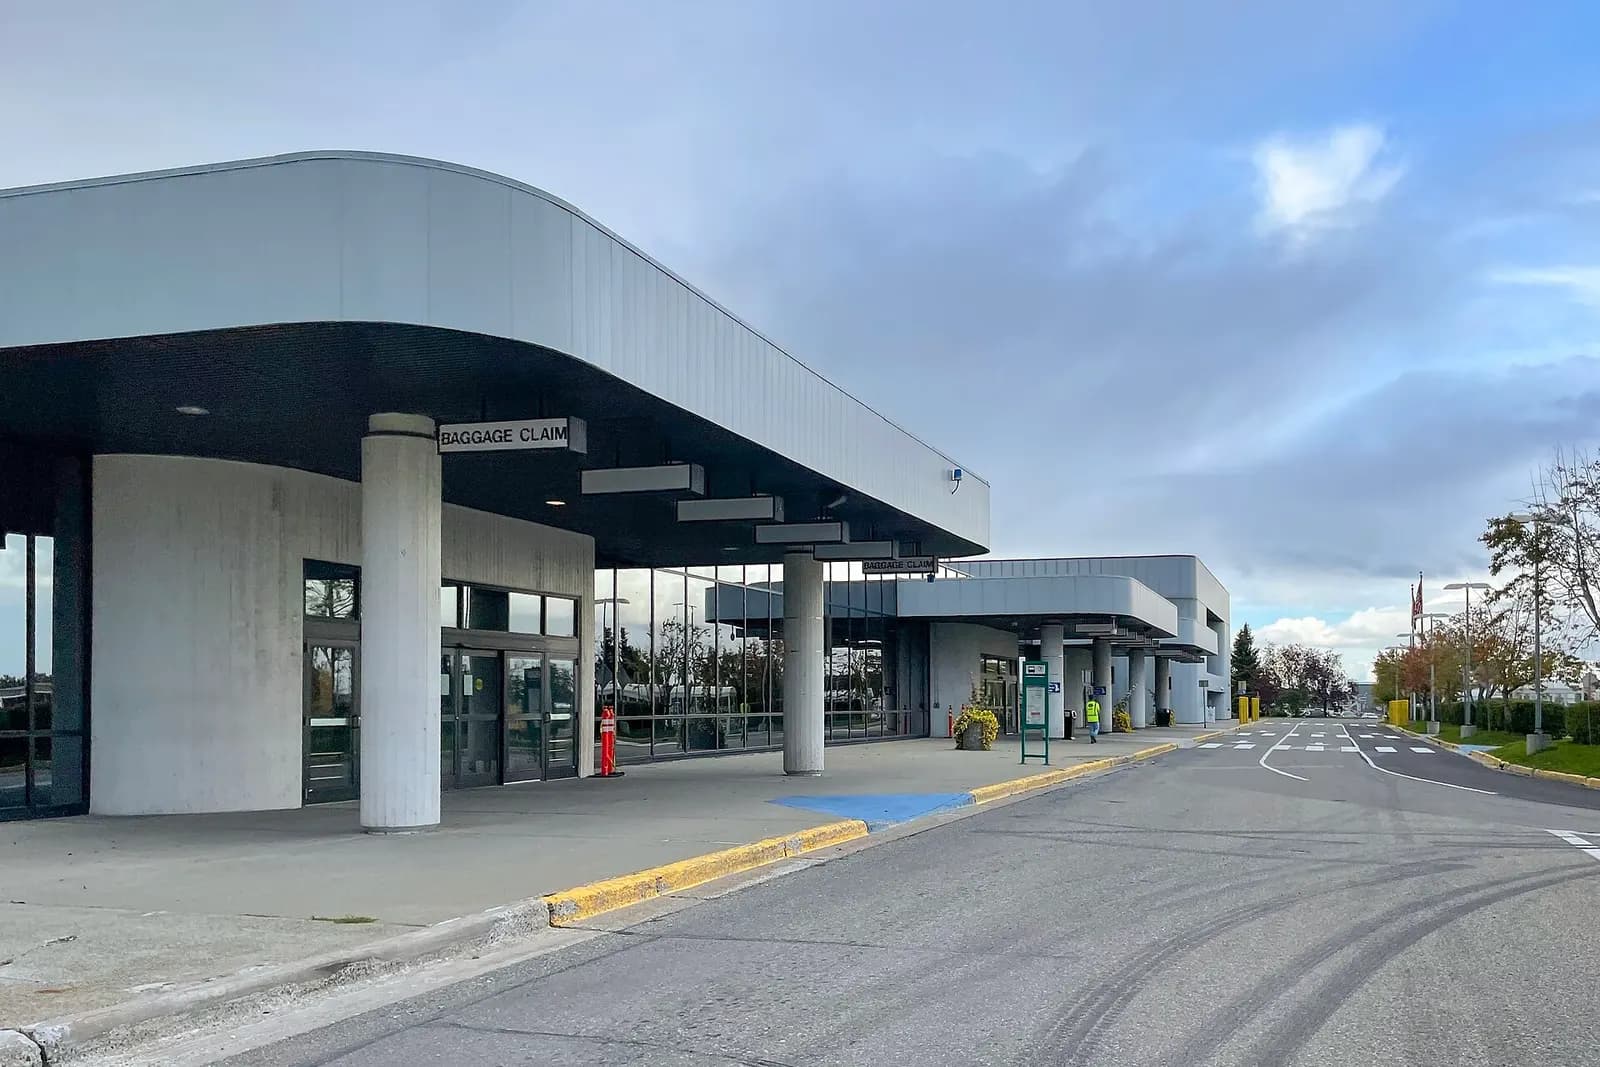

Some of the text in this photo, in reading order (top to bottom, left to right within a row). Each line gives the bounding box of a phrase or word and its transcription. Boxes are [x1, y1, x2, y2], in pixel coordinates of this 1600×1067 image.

[441, 426, 567, 445] BAGGAGE CLAIM
[864, 561, 903, 569] BAGGAGE
